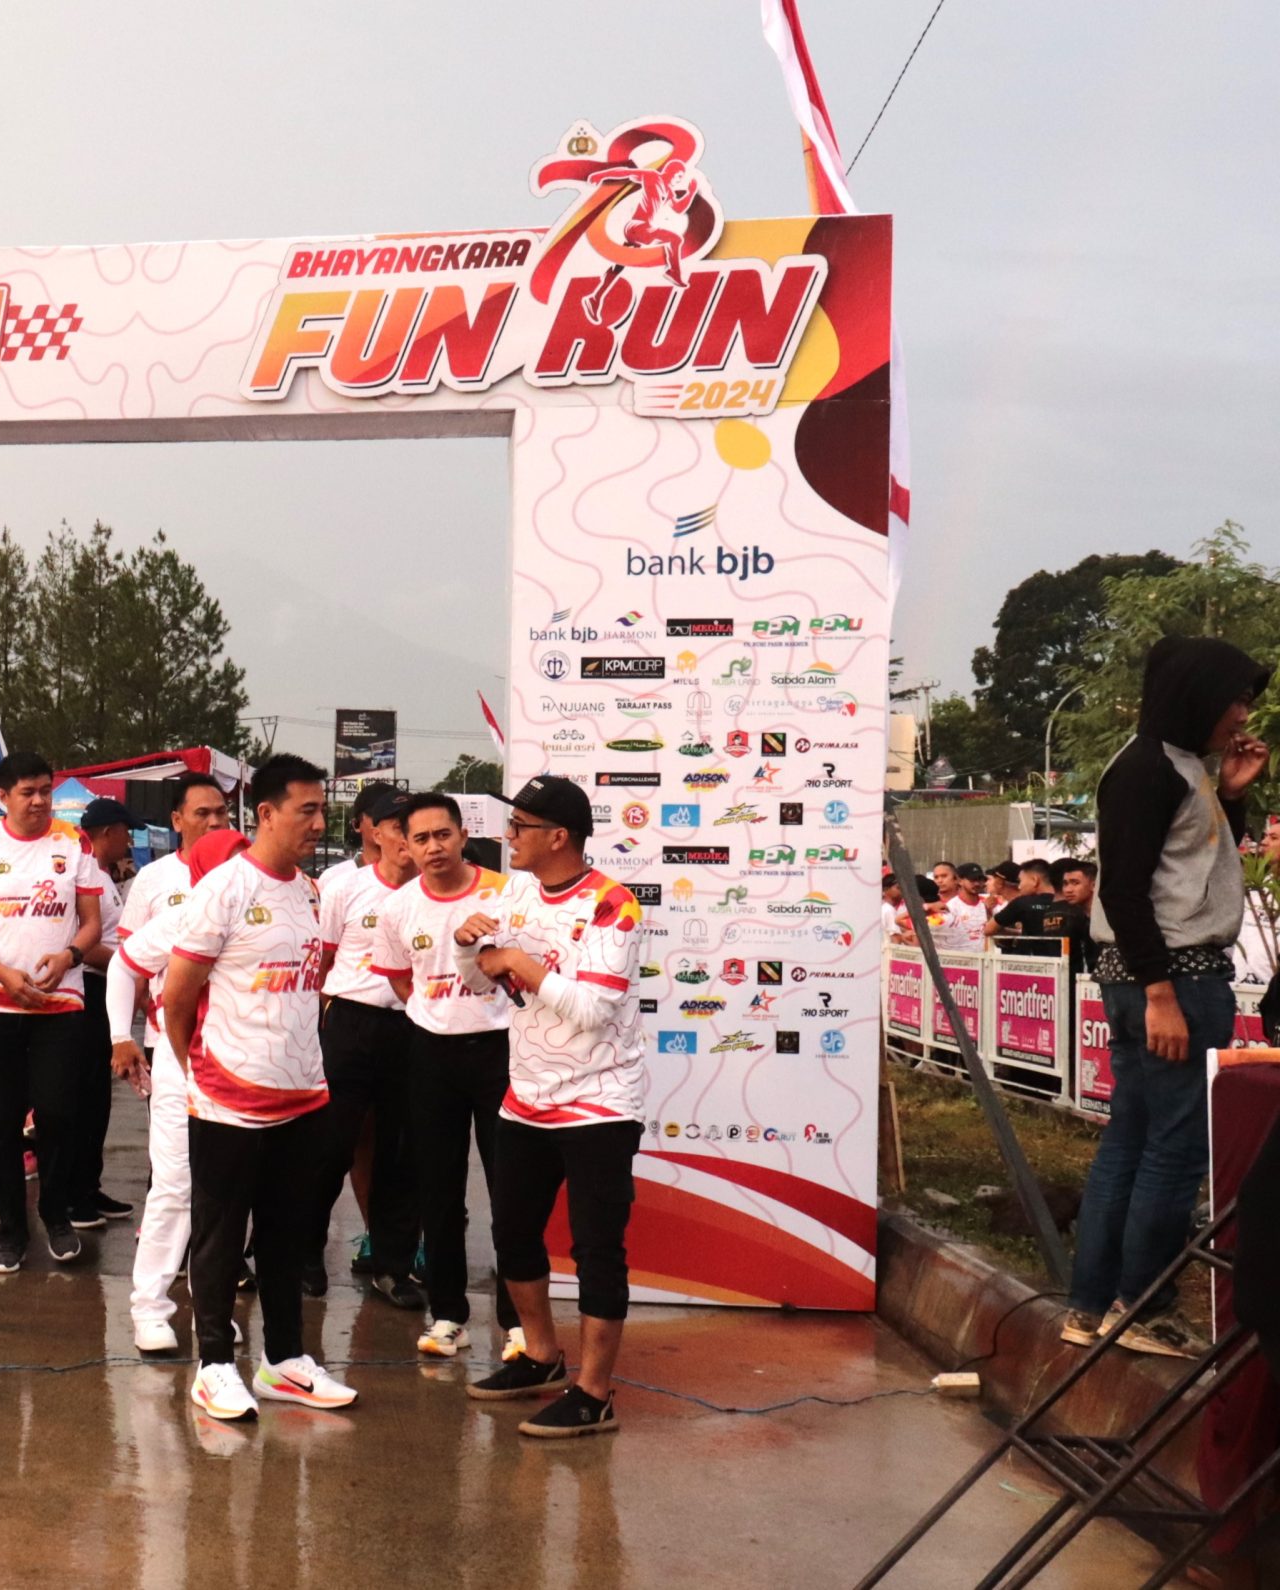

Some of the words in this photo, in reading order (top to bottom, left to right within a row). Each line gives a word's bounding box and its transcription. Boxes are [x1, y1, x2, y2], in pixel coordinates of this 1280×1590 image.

[287, 239, 532, 278] BHAYANGKARA
[249, 282, 517, 390] FUN
[534, 265, 816, 374] RUN
[679, 379, 776, 410] 2024
[626, 547, 706, 576] bank
[716, 546, 775, 581] bjb
[529, 627, 566, 641] bank
[571, 626, 598, 643] bjb
[603, 631, 657, 639] HARMONI
[605, 660, 663, 671] KPMCORP
[771, 676, 806, 685] Sabda
[808, 676, 836, 685] Alam
[542, 702, 606, 712] HANJUANG
[682, 773, 730, 783] ADISON
[804, 780, 821, 788] RIO
[822, 780, 853, 788] SPORT
[600, 857, 653, 865] HARMONI
[31, 902, 68, 917] RUN
[767, 905, 802, 914] Sabda
[803, 905, 832, 914] Alam
[250, 970, 300, 993] FUN
[302, 969, 320, 992] RU
[890, 968, 921, 999] smartfren
[935, 975, 978, 1008] artfren
[679, 1000, 727, 1010] ADISON
[1000, 983, 1055, 1020] smartfren
[801, 1009, 816, 1017] RIO
[818, 1009, 849, 1017] SPORT
